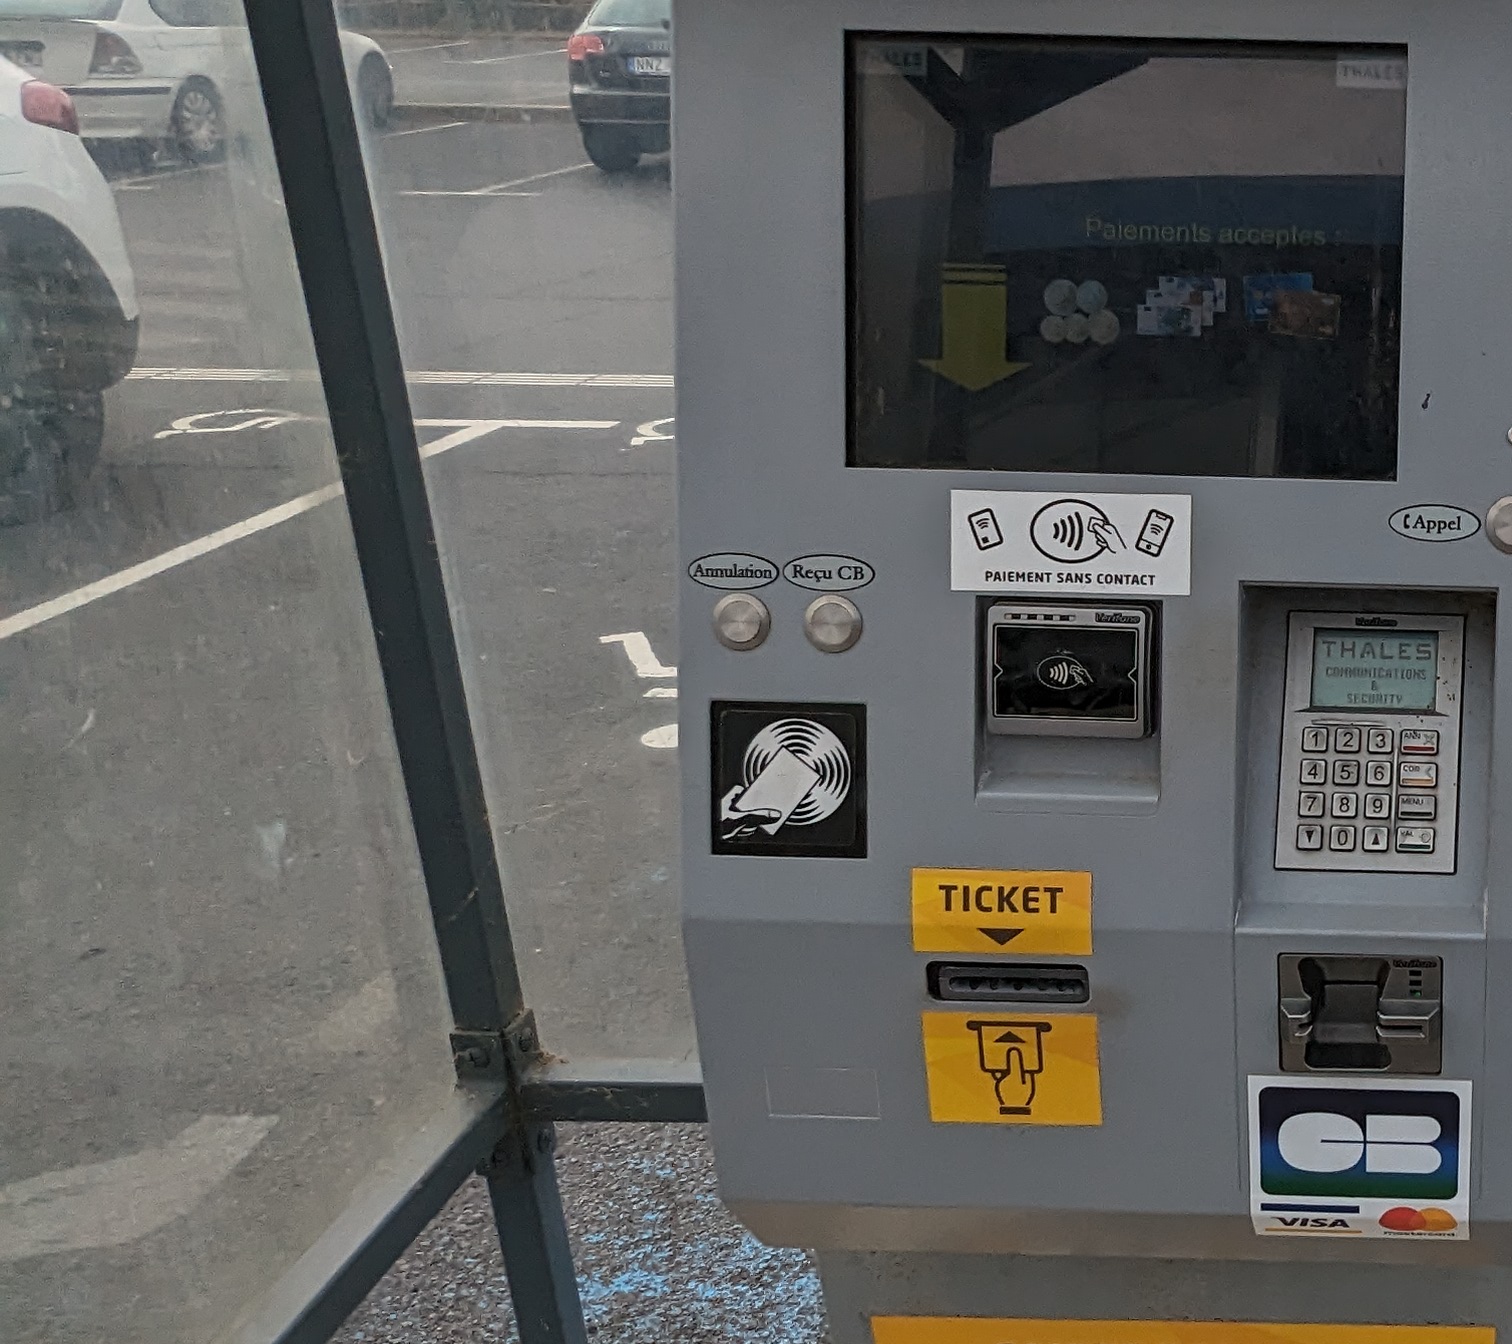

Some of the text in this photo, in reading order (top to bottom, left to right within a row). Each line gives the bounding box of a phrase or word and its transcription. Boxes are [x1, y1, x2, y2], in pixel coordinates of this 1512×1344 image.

[1086, 218, 1211, 243] Paiements
[1412, 514, 1461, 534] Appel
[693, 563, 773, 579] Annulation
[792, 564, 865, 582] Reçu CB
[985, 570, 1156, 586] PAIEMENT SANS CONTACT
[1322, 640, 1432, 661] THALES
[1325, 666, 1427, 680] COMMUNICATIONS
[1346, 692, 1403, 704] SECURITY
[1311, 731, 1318, 747] 1
[1343, 732, 1354, 748] 2
[1375, 733, 1386, 748] 3
[1307, 764, 1318, 779] 4
[1339, 764, 1351, 780] 5
[1373, 765, 1385, 781] 6
[1306, 796, 1424, 813] 7 8 9 MENU
[1337, 829, 1349, 846] 0
[939, 885, 1064, 916] TICKET
[1278, 1111, 1442, 1174] CB
[1270, 1216, 1350, 1228] VISA
